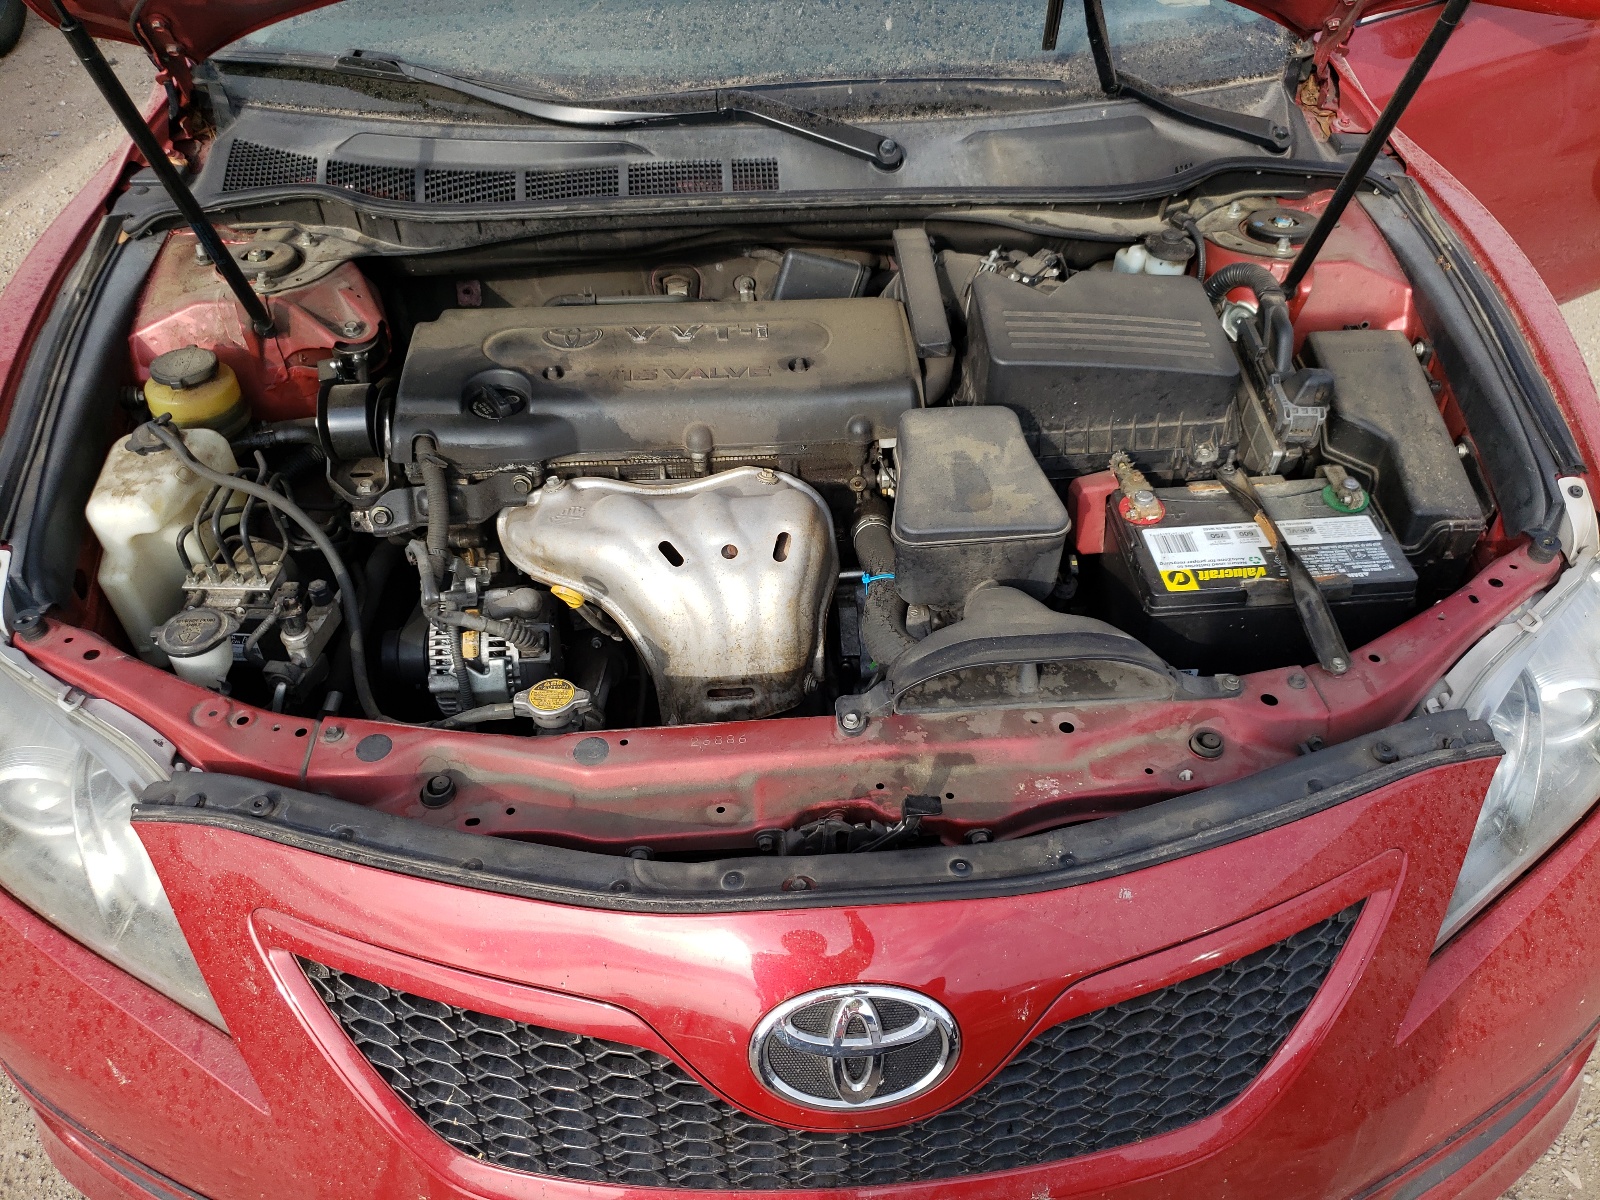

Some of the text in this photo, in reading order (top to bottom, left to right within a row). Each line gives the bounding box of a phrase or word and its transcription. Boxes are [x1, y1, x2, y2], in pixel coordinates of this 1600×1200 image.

[663, 366, 771, 380] VALVE
[1198, 566, 1267, 581] Valucraft
[690, 734, 747, 747] 26886
